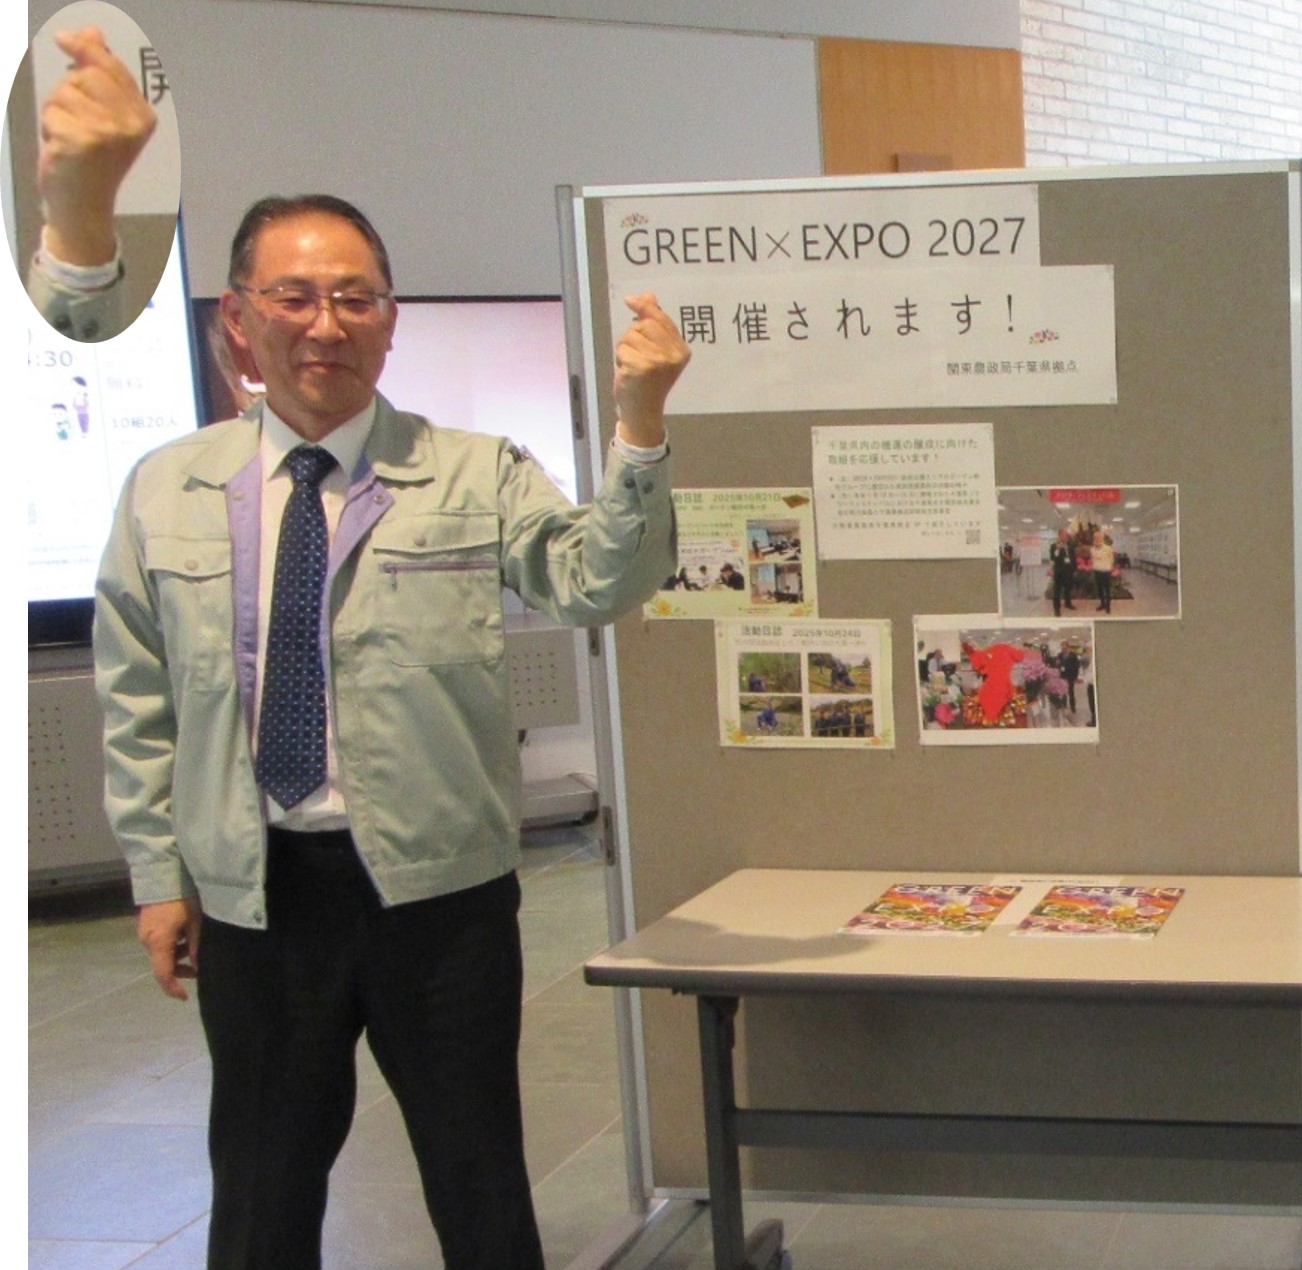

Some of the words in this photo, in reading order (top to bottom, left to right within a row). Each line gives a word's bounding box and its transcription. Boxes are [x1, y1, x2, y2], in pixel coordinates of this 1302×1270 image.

[928, 217, 1026, 258] 2027
[631, 293, 1015, 344] 開催されます！
[28, 350, 73, 367] :30
[946, 359, 1079, 376] 関東農政局千葉県拠点
